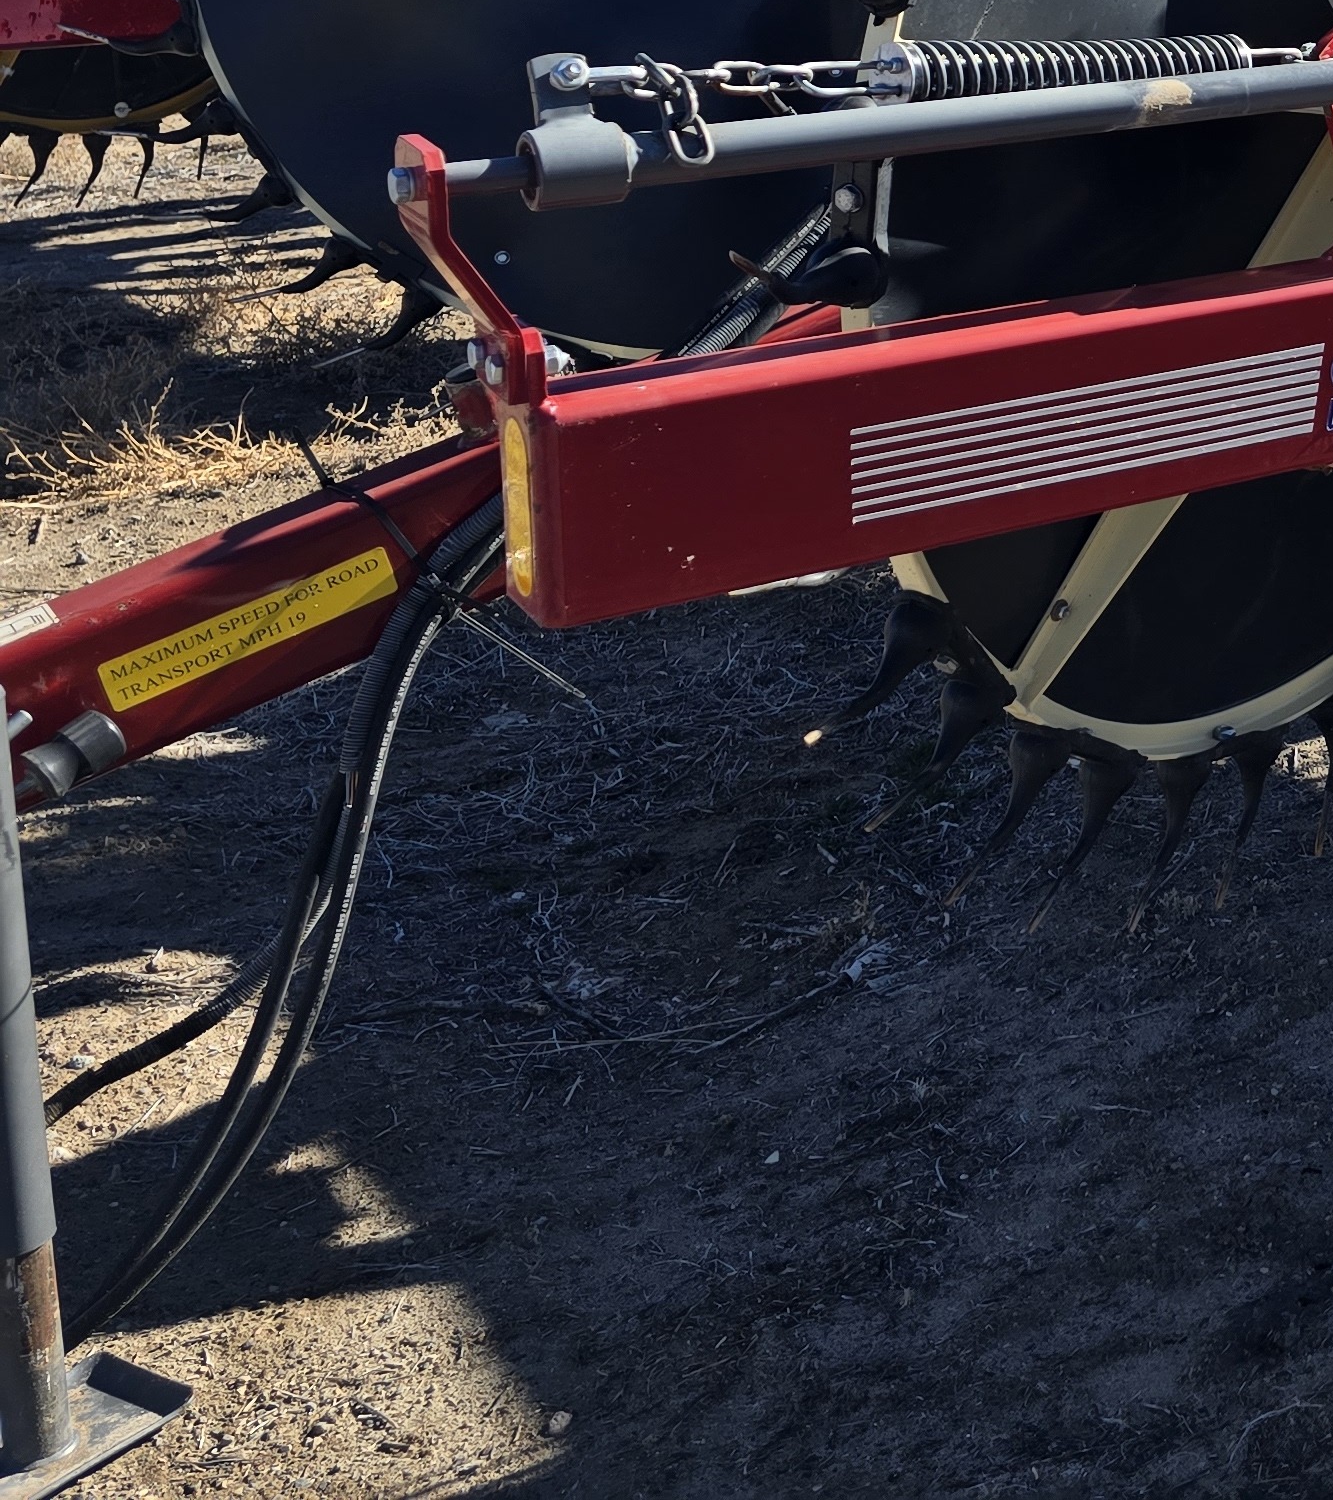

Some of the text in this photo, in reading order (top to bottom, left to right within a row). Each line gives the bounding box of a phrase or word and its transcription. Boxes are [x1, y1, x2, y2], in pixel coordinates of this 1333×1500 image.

[110, 558, 379, 681] MAXIMUM SPEED FOR ROAD
[118, 611, 306, 700] TRANSPORT MPH 19
